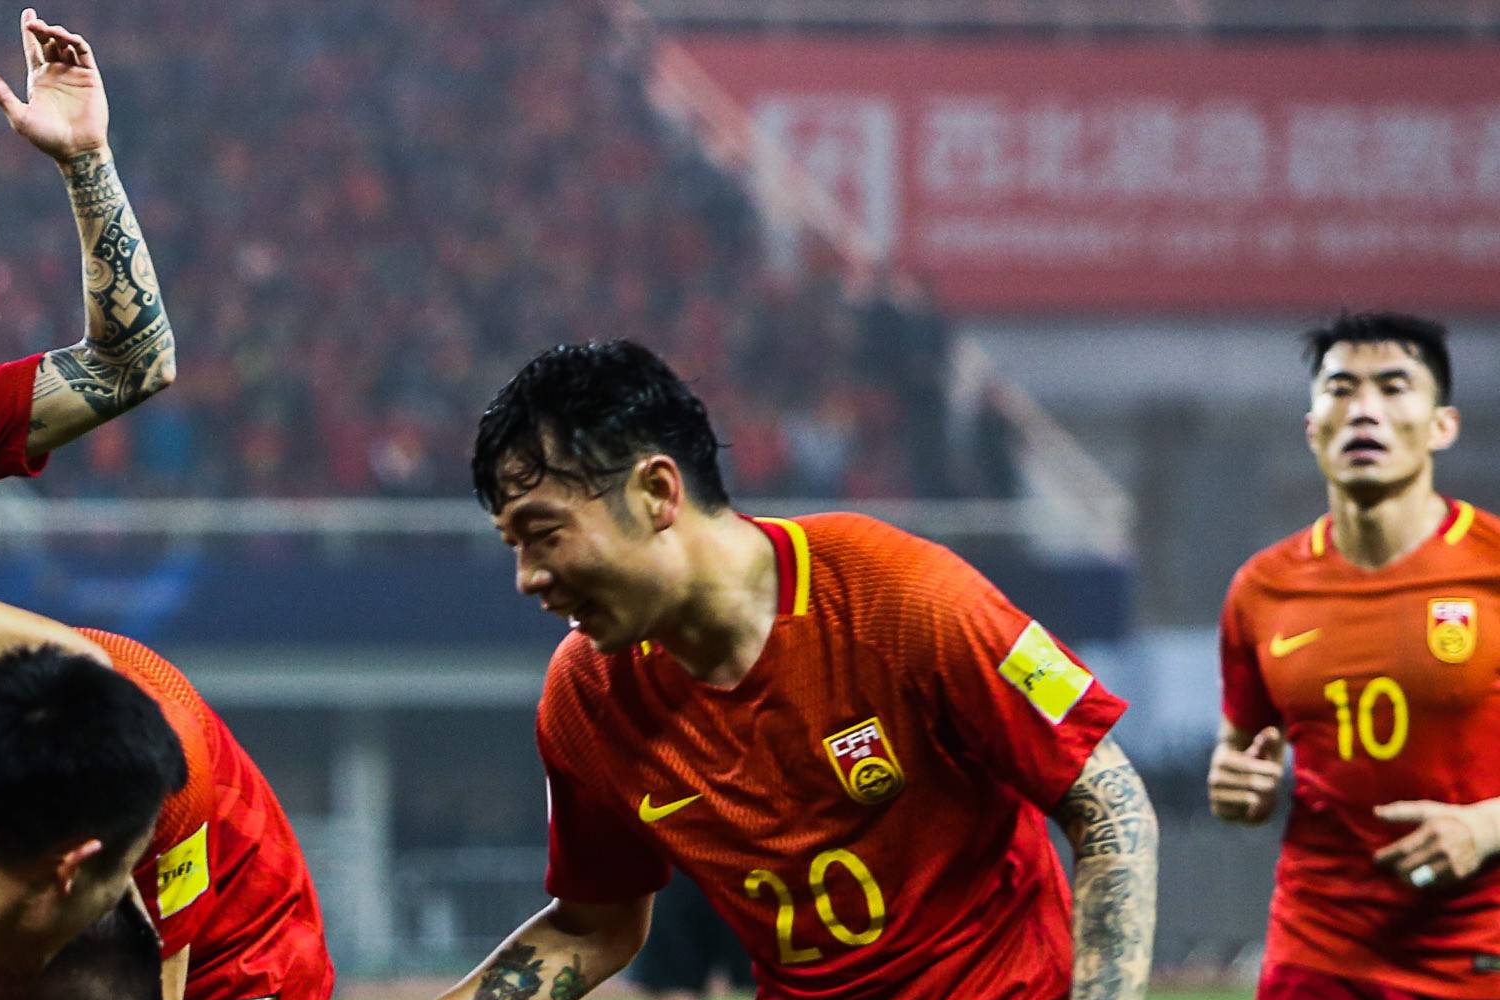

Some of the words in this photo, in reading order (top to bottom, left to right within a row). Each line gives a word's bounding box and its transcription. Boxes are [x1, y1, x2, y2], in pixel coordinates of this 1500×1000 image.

[830, 724, 880, 757] CFA
[1324, 676, 1408, 761] 10
[744, 848, 886, 964] 20
